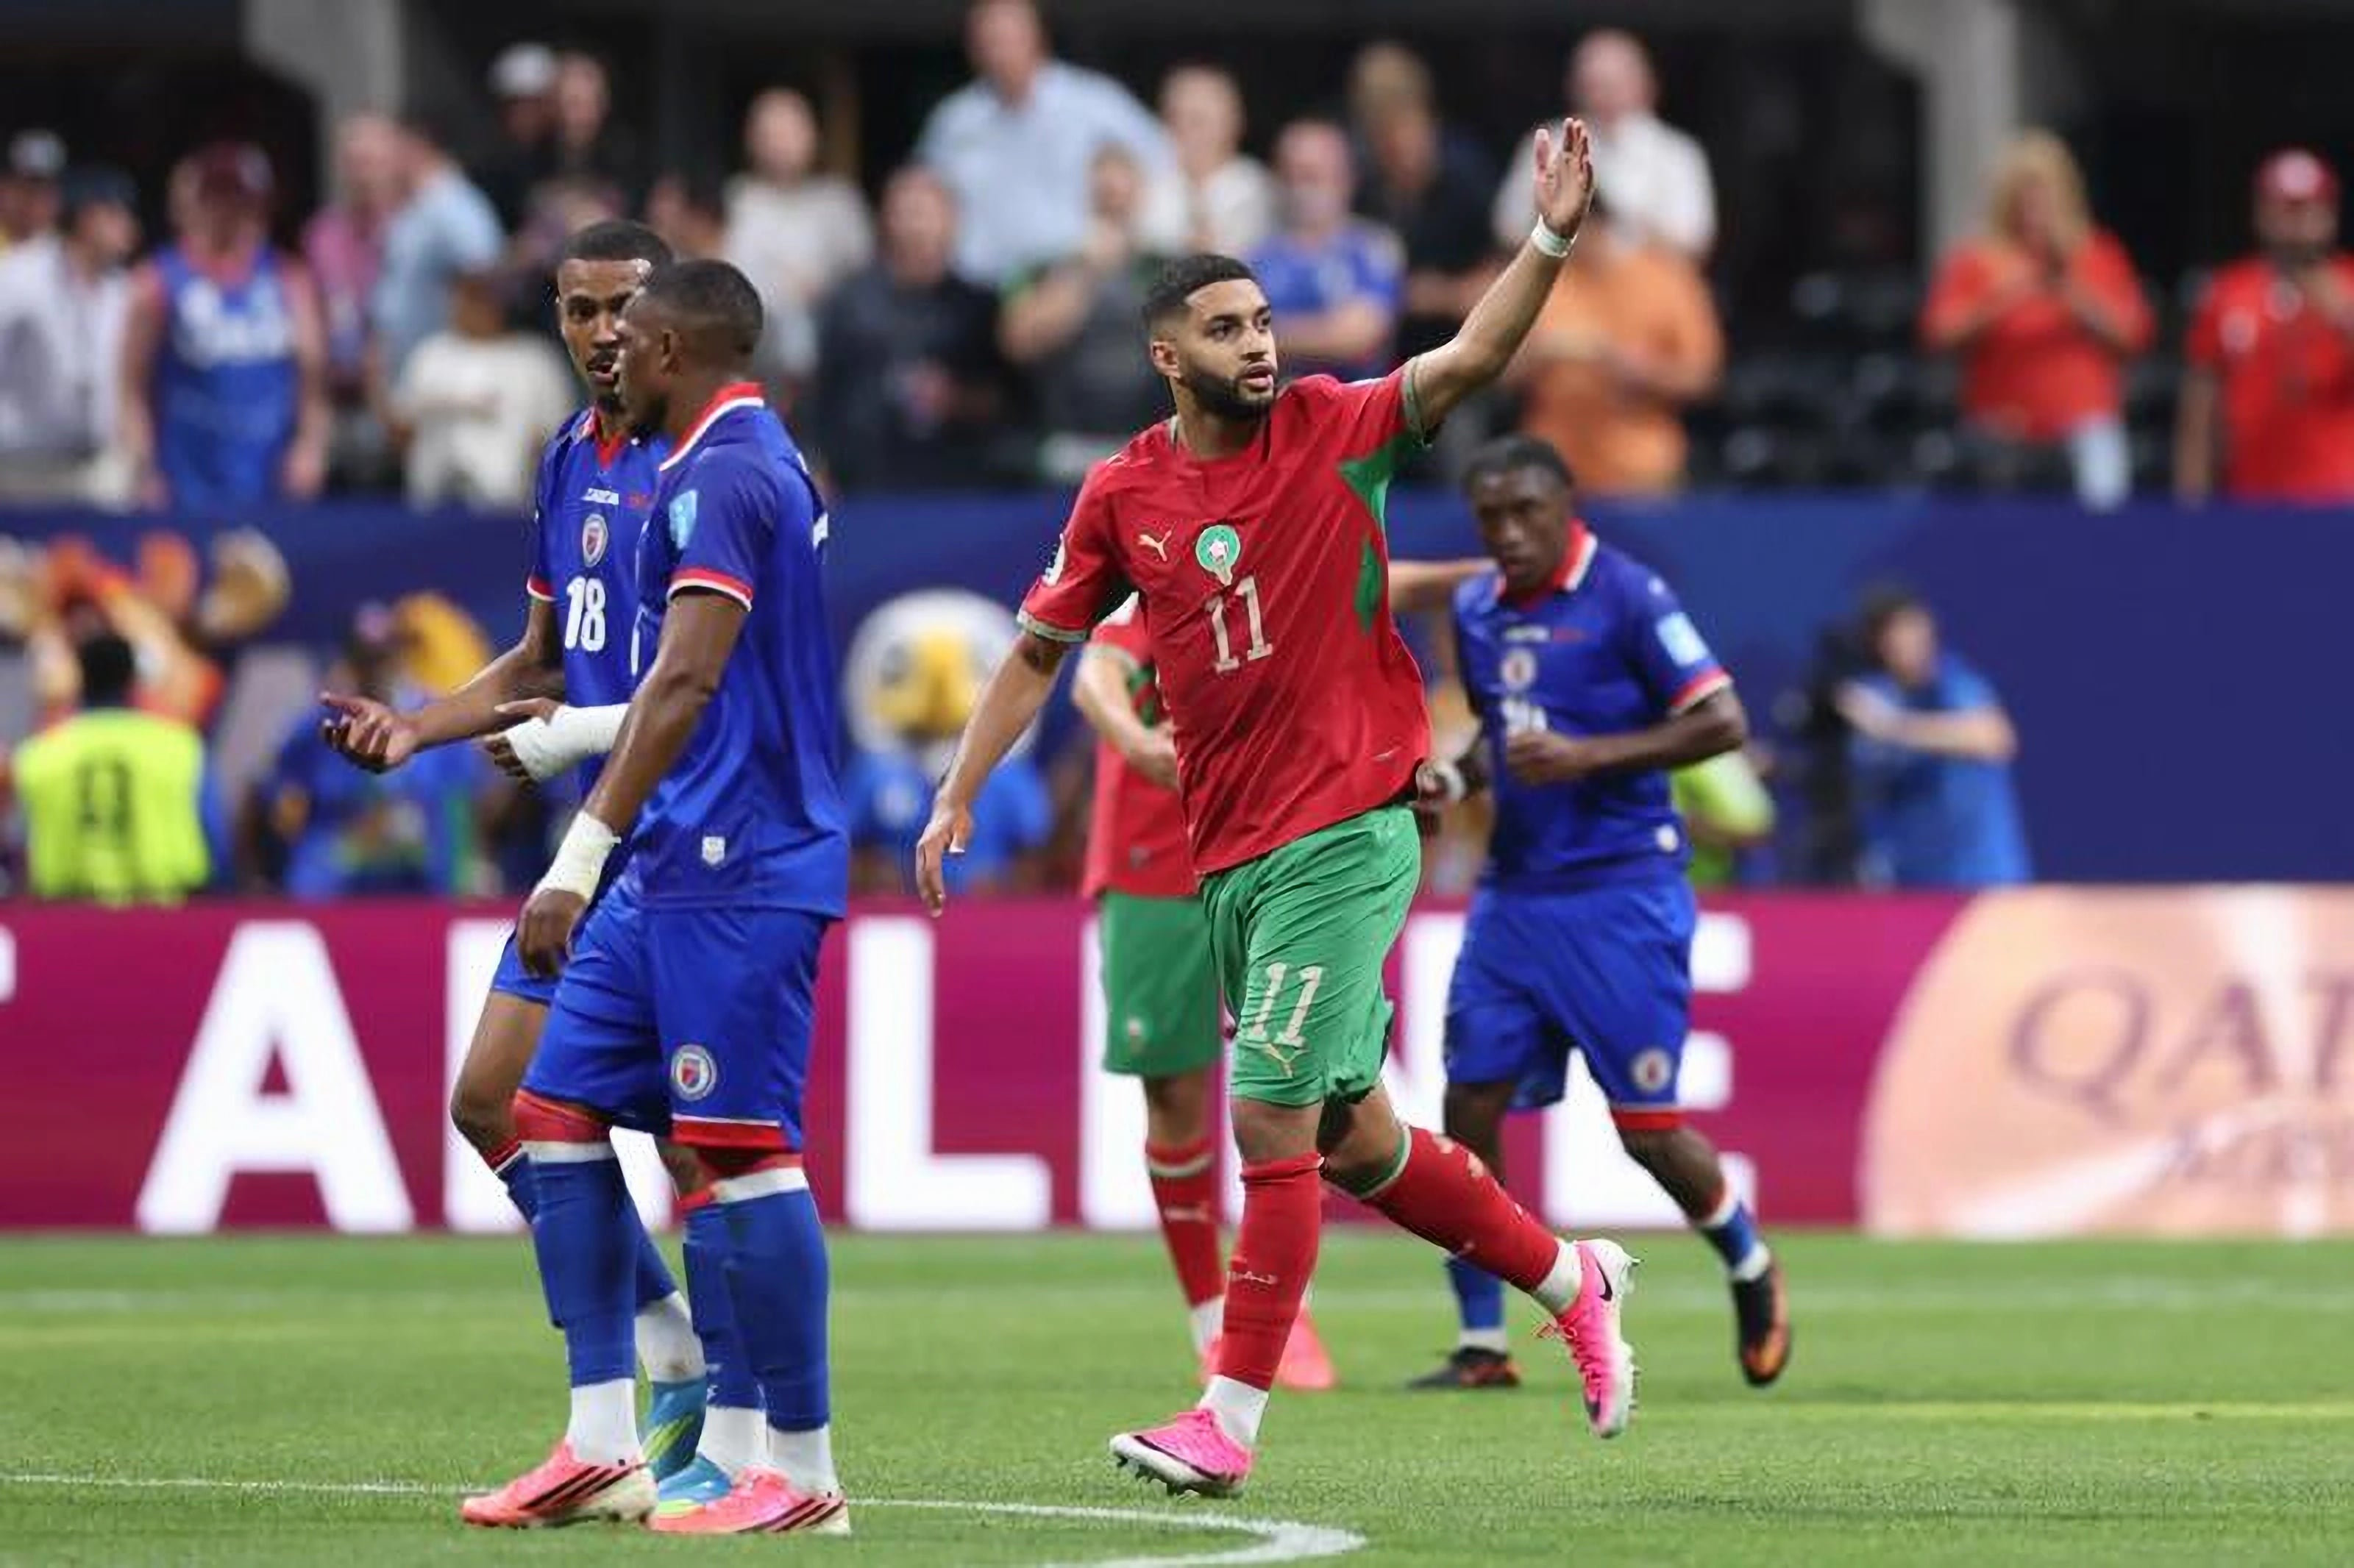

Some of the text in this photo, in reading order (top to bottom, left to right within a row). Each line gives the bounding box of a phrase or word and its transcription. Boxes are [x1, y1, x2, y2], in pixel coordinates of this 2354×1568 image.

[564, 576, 607, 652] 18
[1204, 574, 1274, 675] 11
[1246, 961, 1323, 1047] 11
[134, 912, 1757, 1233] AILIE
